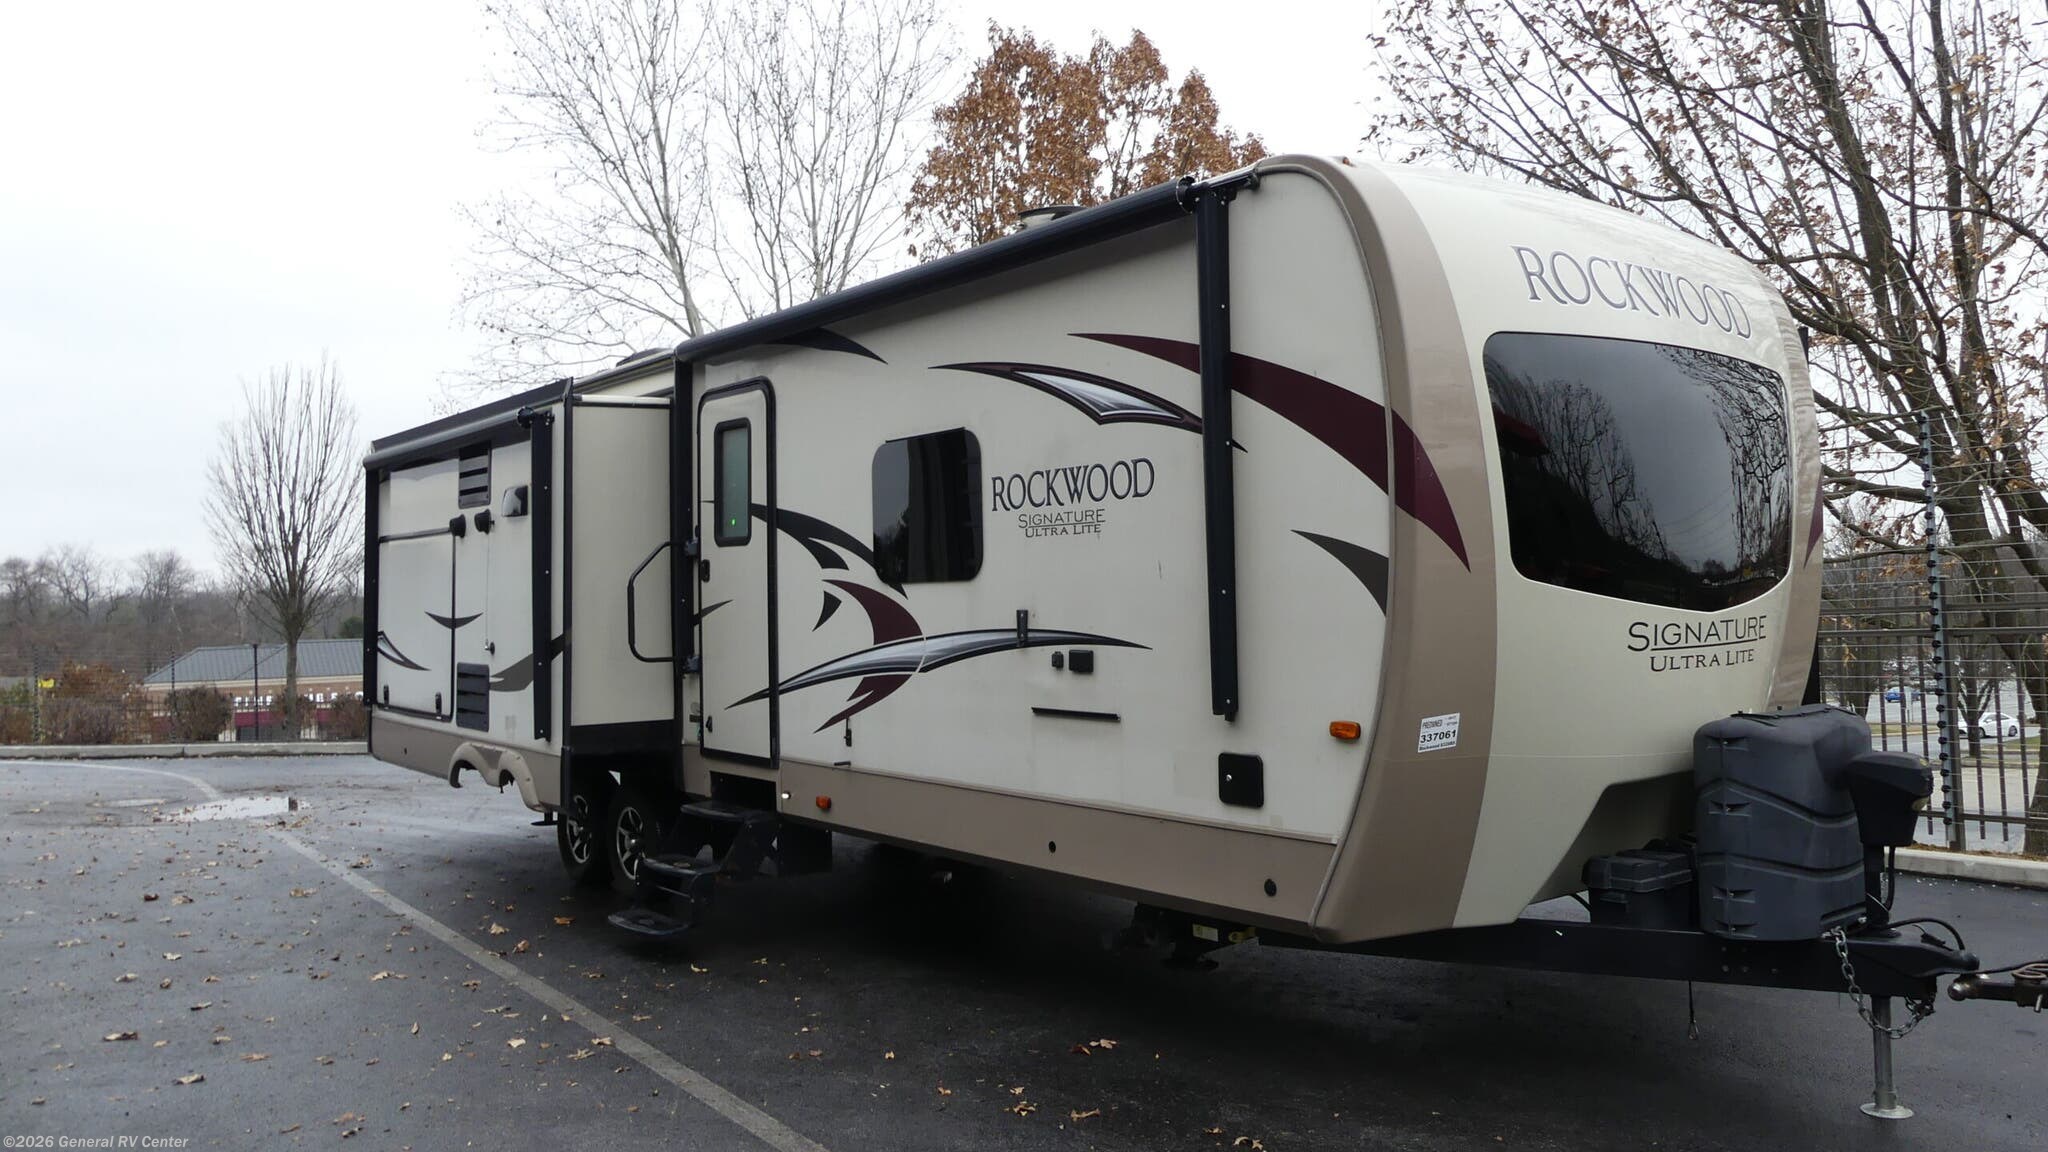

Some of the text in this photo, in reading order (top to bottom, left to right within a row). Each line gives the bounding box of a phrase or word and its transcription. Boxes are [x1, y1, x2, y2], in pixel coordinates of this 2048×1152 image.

[1510, 245, 1751, 339] ROCKWOOD
[991, 457, 1155, 512] ROCKWOOD
[1018, 508, 1106, 528] SIGNATURE
[1025, 523, 1102, 538] ULTRA LITE
[1627, 615, 1767, 652] SIGNATURE
[1650, 648, 1755, 672] ULTRA LITE
[1420, 730, 1456, 744] 337061
